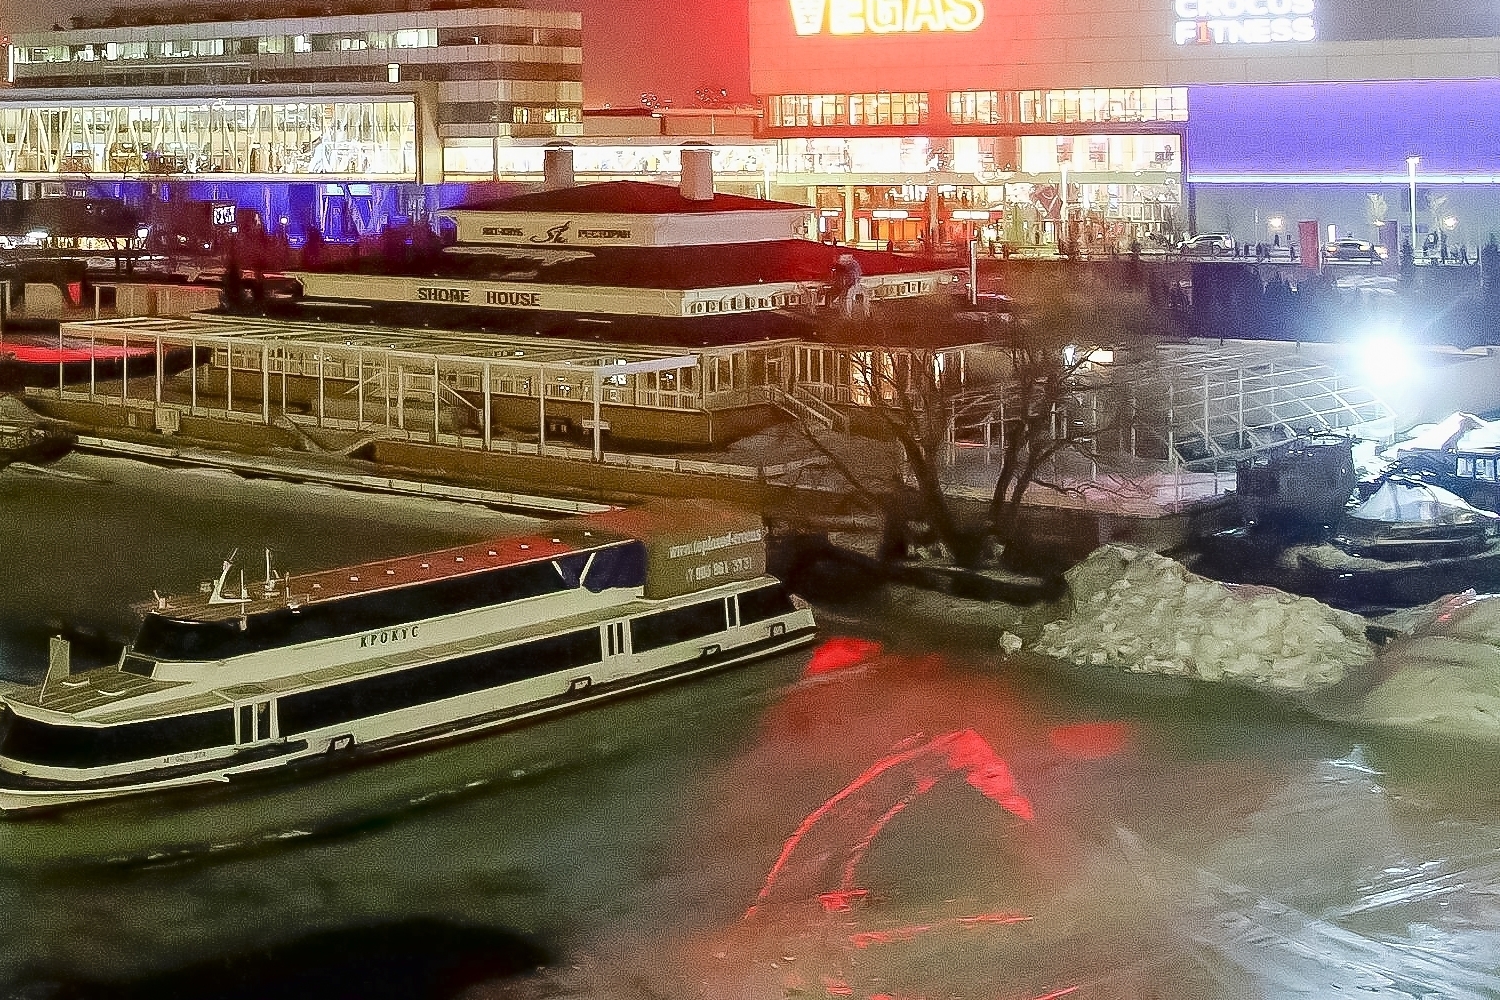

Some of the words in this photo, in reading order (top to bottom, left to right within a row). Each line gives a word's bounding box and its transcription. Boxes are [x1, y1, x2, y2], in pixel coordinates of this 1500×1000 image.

[1174, 16, 1317, 45] FITNESS
[417, 287, 471, 303] SHORE
[485, 290, 542, 307] HOUSE
